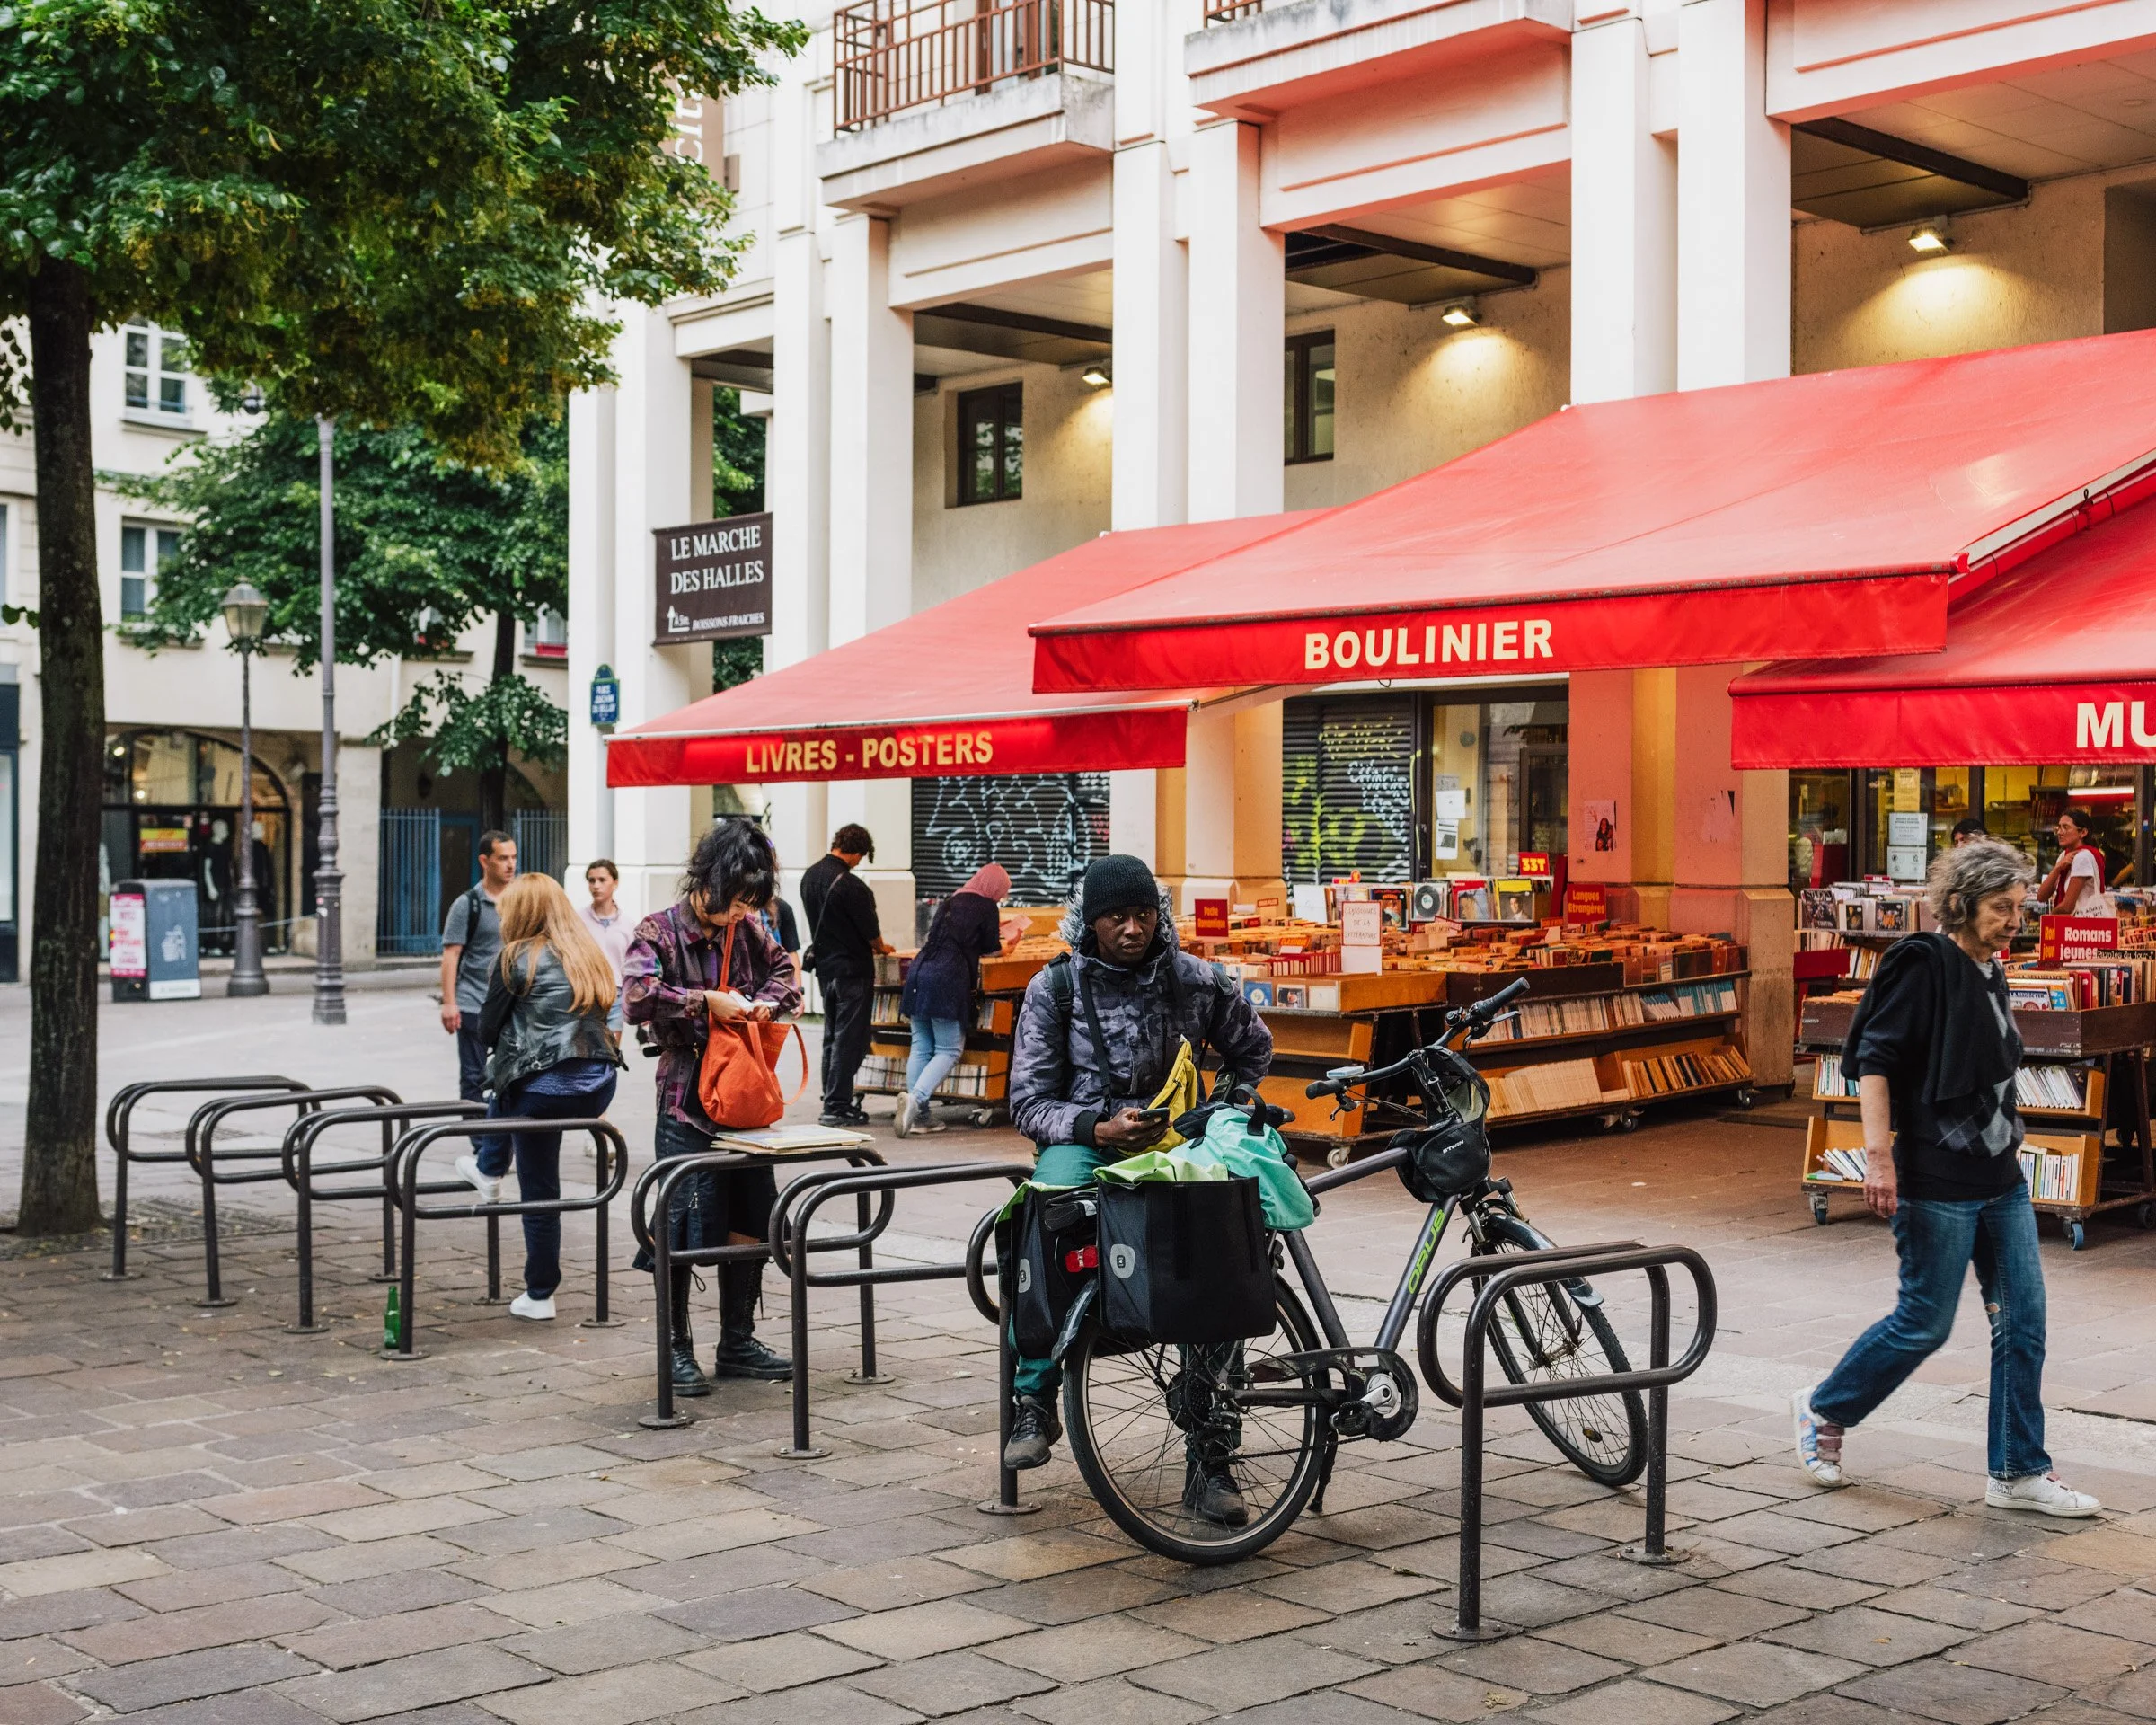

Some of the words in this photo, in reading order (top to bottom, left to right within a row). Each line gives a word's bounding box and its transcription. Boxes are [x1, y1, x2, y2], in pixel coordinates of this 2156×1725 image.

[670, 536, 691, 561] LE
[693, 525, 762, 557] MARCHE
[670, 569, 701, 595] DES
[702, 560, 764, 590] HALLES
[1304, 618, 1554, 669] BOULINIER
[2076, 701, 2156, 748] MU
[746, 739, 837, 774] LIVRES
[862, 731, 994, 769] POSTERS
[1521, 858, 1546, 871] 33T
[1572, 890, 1600, 902] Langues
[2064, 926, 2112, 942] Romans
